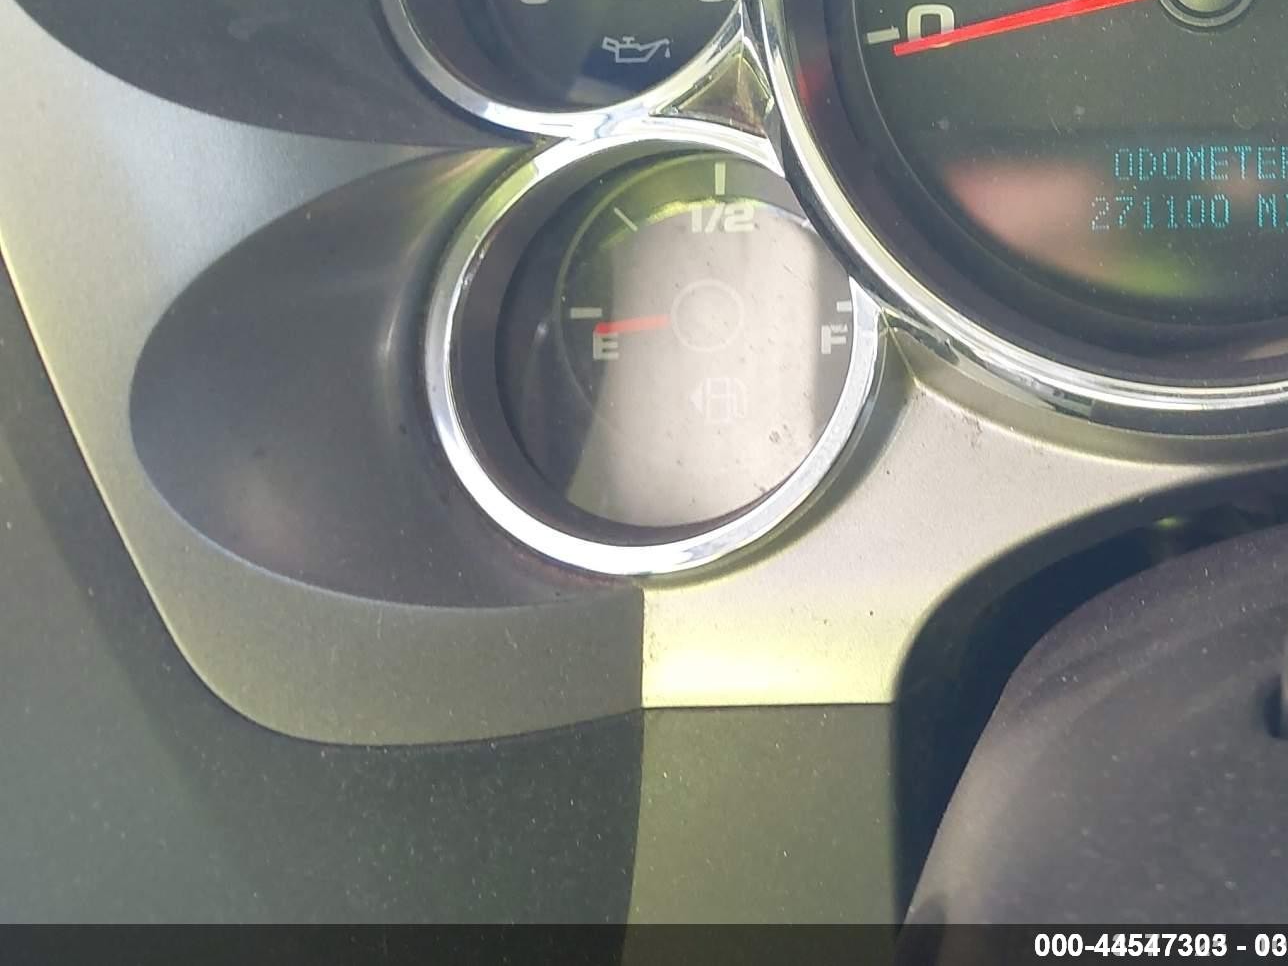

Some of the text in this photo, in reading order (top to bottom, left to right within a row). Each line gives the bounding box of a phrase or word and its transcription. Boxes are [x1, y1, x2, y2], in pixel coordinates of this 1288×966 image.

[907, 4, 955, 46] 0
[685, 201, 756, 233] 1/2
[1091, 194, 1230, 231] 271100
[593, 332, 619, 360] E
[821, 324, 848, 355] F
